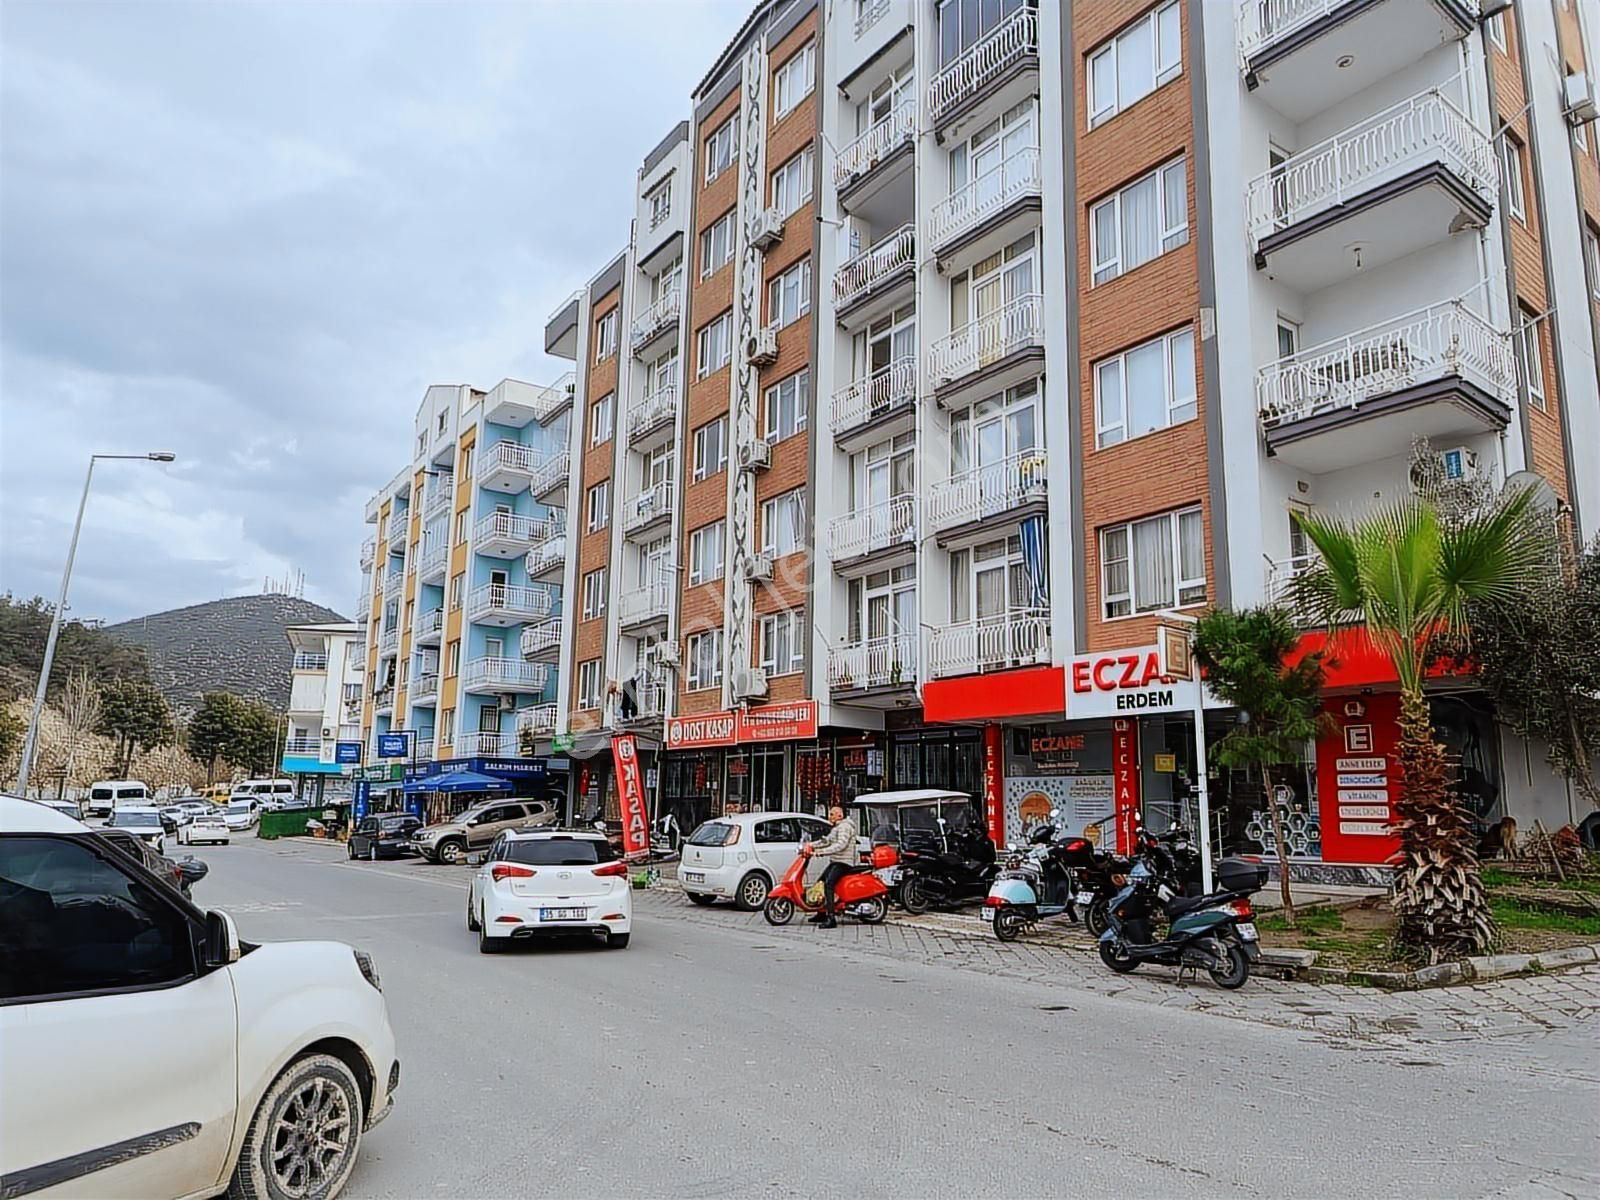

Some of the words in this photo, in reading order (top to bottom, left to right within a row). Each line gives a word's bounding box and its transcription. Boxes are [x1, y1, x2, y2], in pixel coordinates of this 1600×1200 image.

[1072, 651, 1178, 693] ECZA
[1116, 690, 1173, 709] ERDEM
[683, 721, 706, 741] DOST
[705, 717, 734, 739] KASAP
[1349, 727, 1368, 750] E
[1031, 734, 1084, 753] ECZANE
[986, 745, 996, 831] ECZANE
